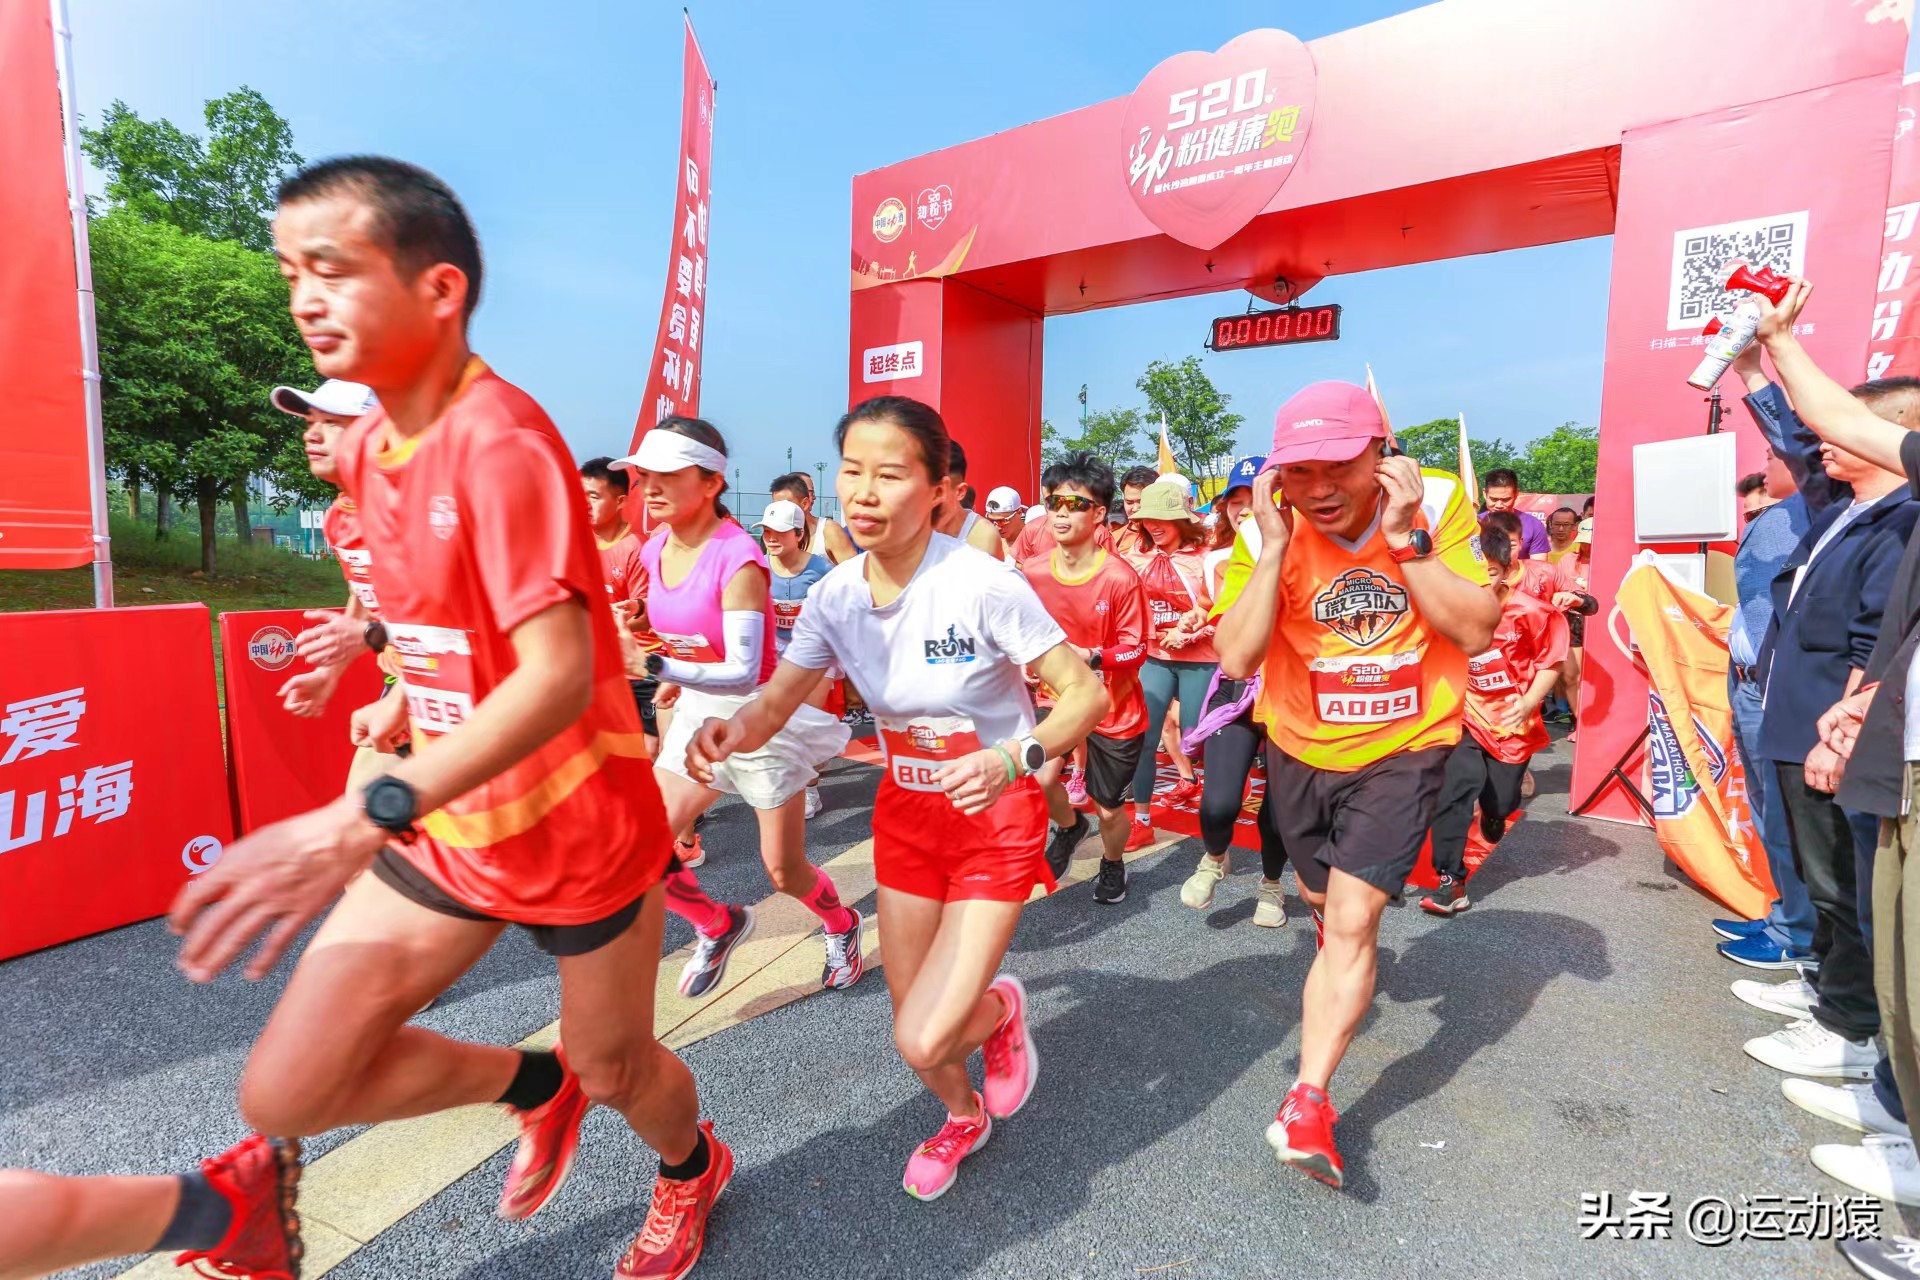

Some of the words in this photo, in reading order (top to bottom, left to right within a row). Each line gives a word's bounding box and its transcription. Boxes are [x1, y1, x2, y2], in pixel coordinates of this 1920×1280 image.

[1167, 68, 1268, 131] 520
[870, 350, 916, 375] 起终点
[1338, 584, 1383, 596] MARATHON
[1346, 577, 1373, 586] MICRO
[1325, 593, 1399, 617] 微马队
[251, 638, 294, 659] 中国劲酒
[924, 637, 976, 658] RUN
[1351, 666, 1383, 675] 520
[1326, 694, 1412, 716] A089
[1660, 722, 1685, 782] MARATHON
